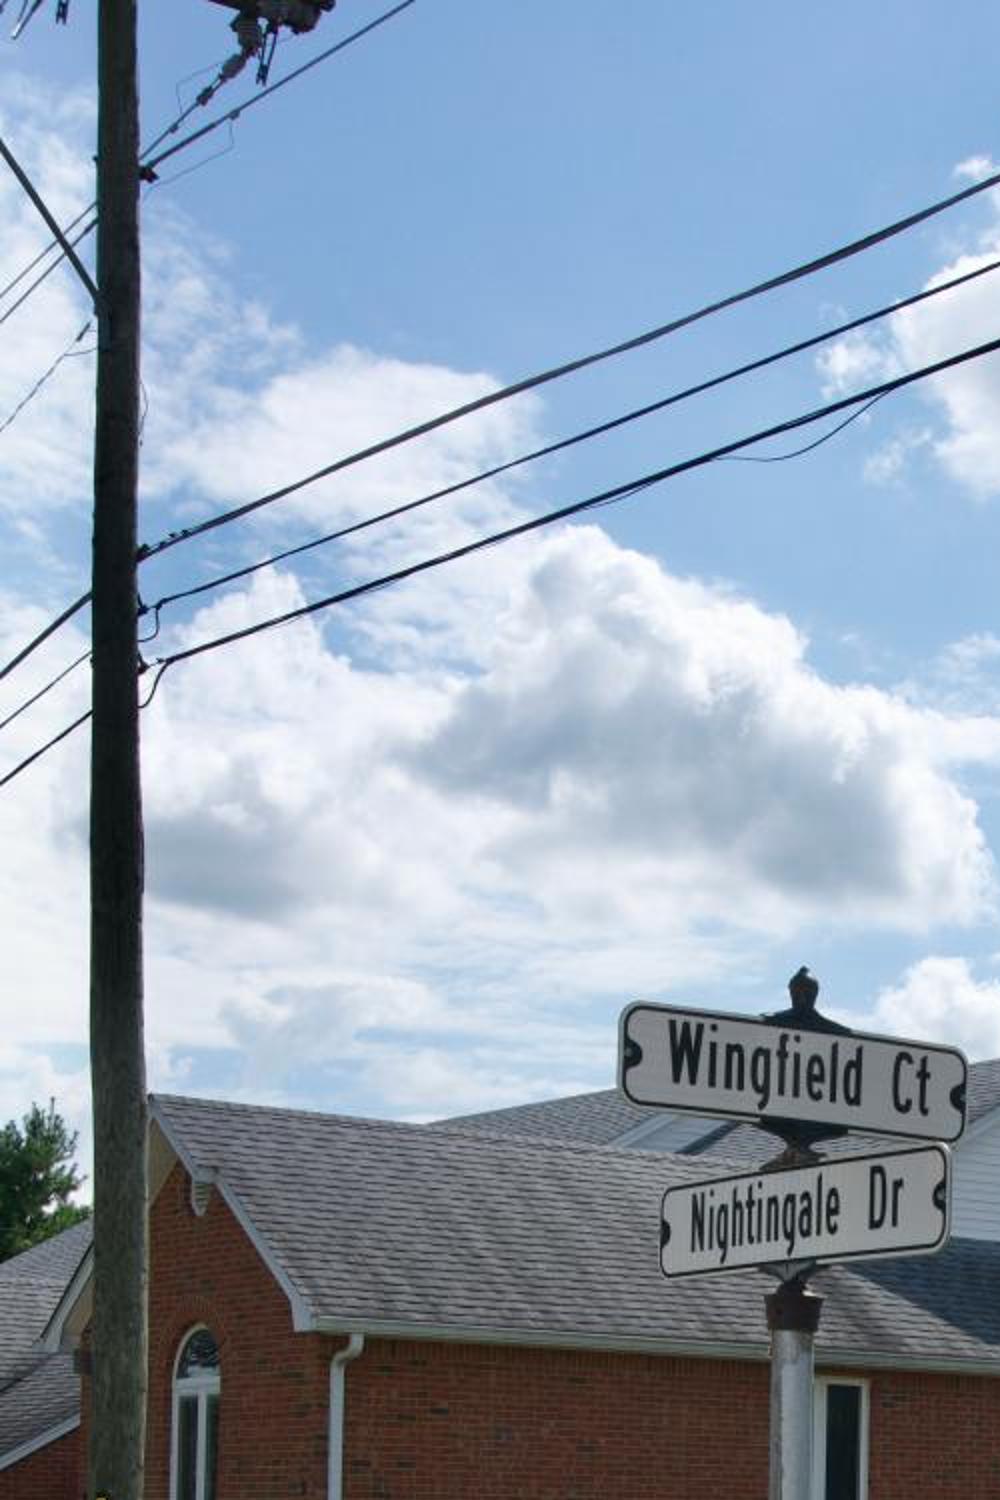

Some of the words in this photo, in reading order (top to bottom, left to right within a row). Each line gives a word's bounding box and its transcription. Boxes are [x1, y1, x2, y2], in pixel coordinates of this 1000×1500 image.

[668, 1019, 863, 1110] Wingfield
[892, 1051, 931, 1116] Ct
[690, 1171, 841, 1264] Nightingale
[868, 1165, 904, 1229] Dr
